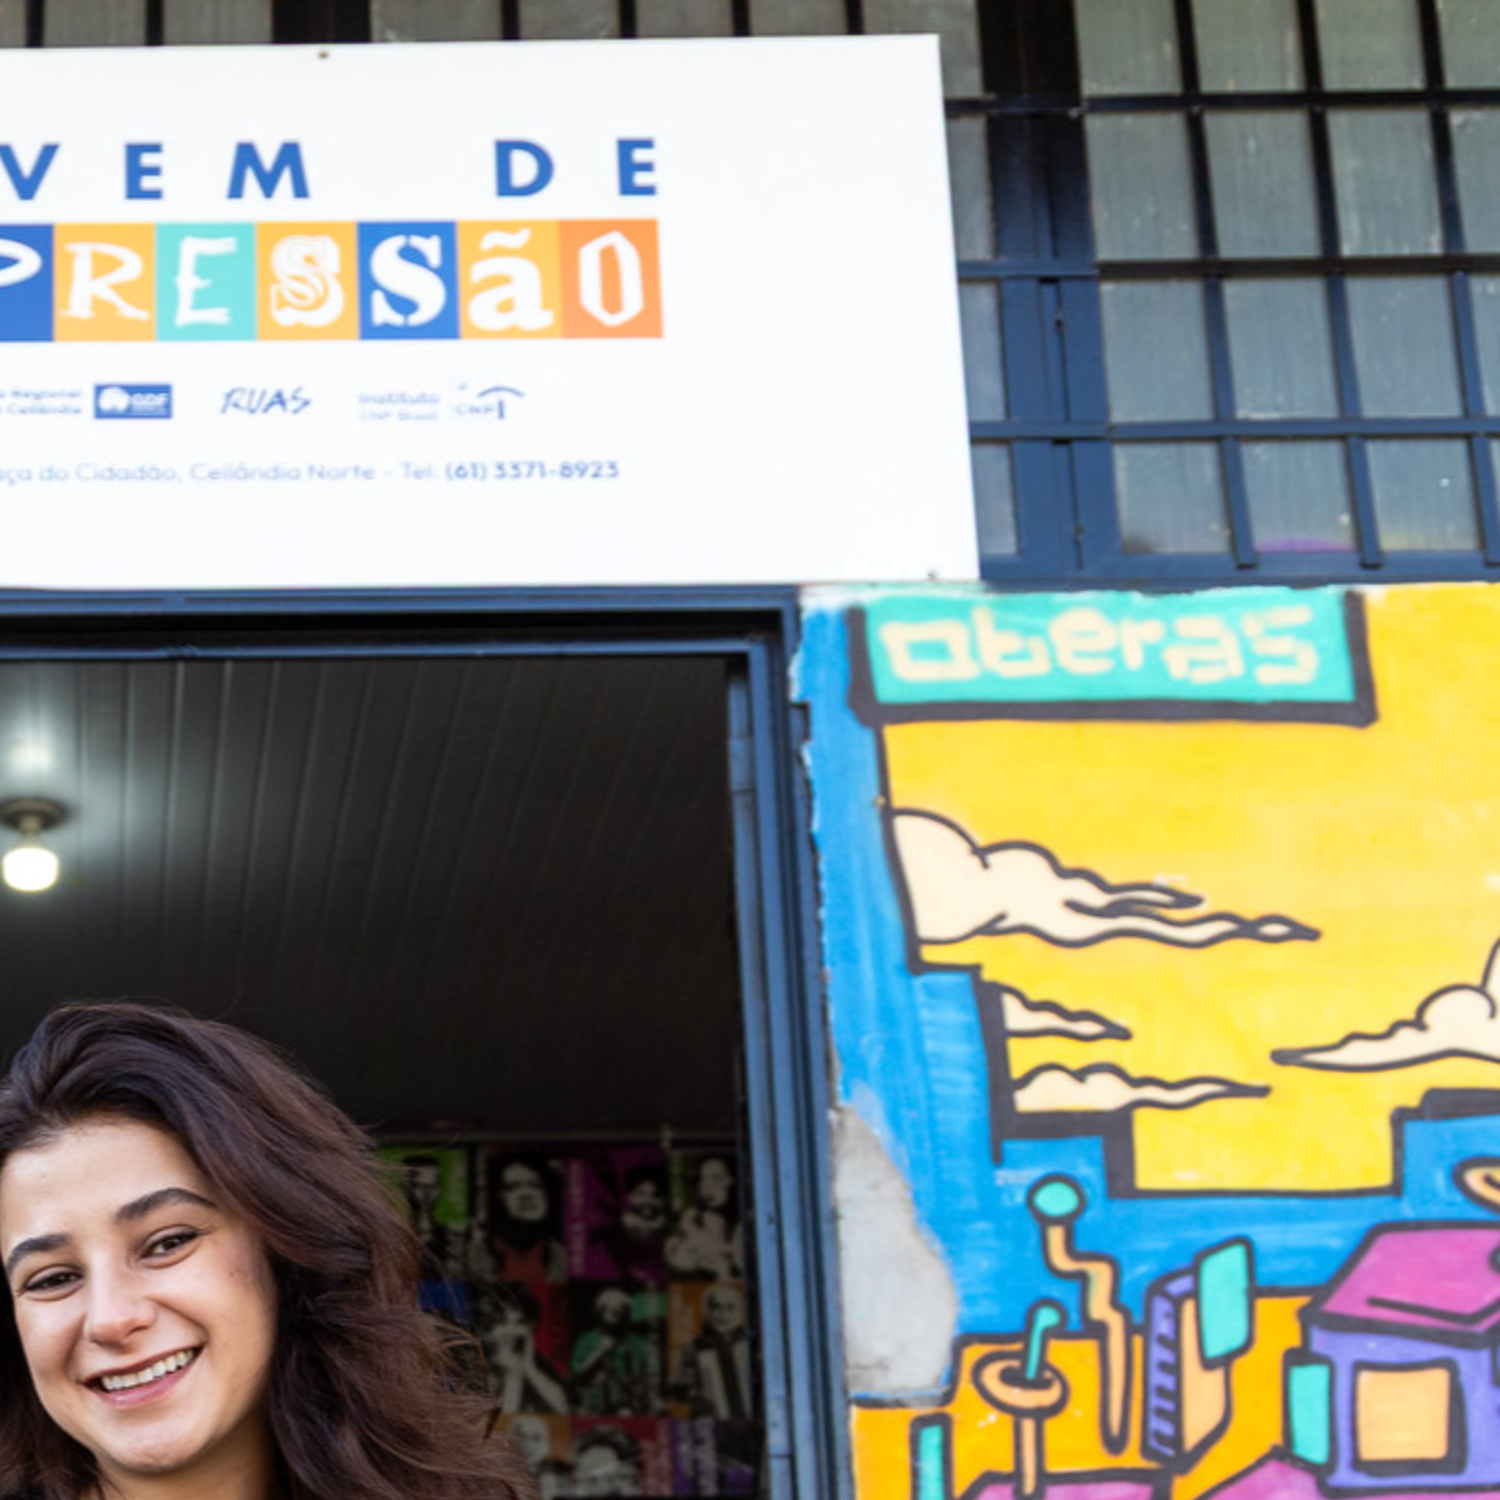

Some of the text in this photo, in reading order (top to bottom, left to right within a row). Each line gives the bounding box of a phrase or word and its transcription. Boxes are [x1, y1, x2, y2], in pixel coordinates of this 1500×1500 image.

[493, 136, 659, 199] DE
[219, 385, 313, 416] RUAS
[358, 391, 441, 405] Instituto
[37, 463, 70, 483] do
[188, 461, 302, 483] Ceilândia
[307, 462, 377, 482] Norte
[444, 460, 488, 483] (61)
[493, 459, 620, 481] 3371-8923
